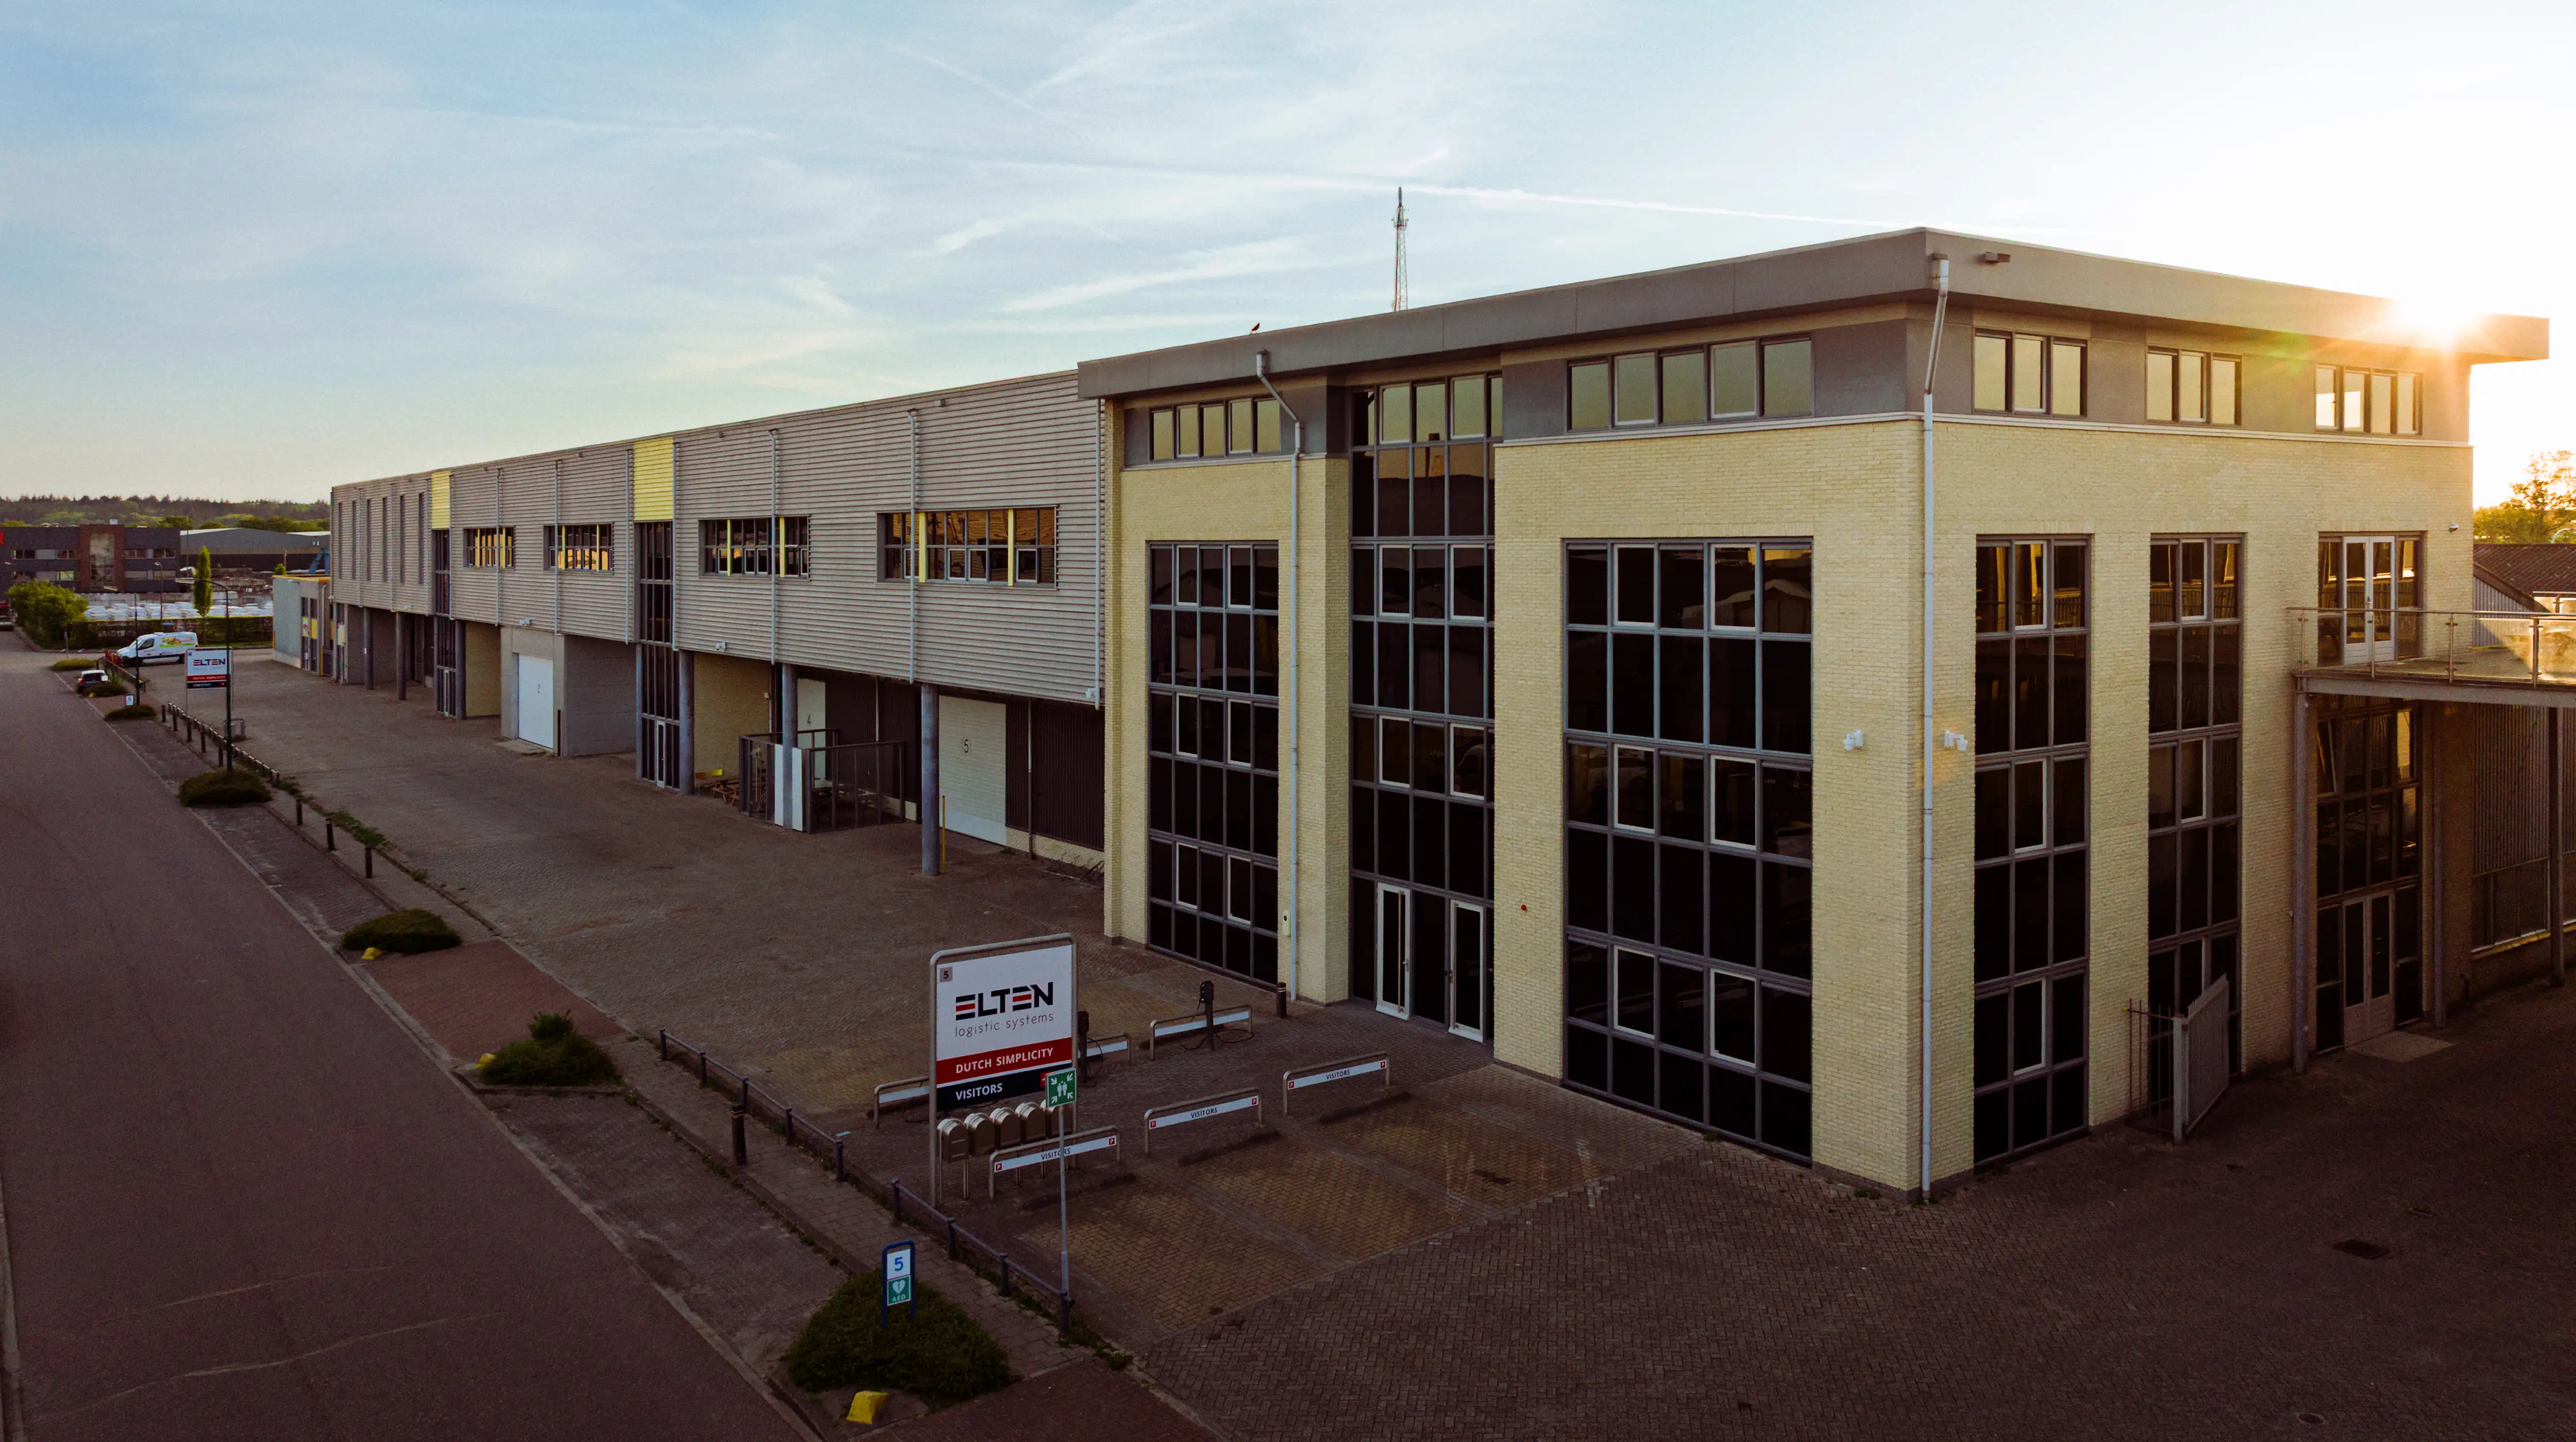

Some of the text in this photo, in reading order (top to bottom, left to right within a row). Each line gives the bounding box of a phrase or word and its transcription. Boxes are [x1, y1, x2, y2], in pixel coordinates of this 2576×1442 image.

[807, 714, 811, 726] 4
[964, 739, 969, 753] 5
[943, 970, 949, 979] 5
[956, 981, 1054, 1021] ELTEN
[955, 1013, 1054, 1038] logistic systems
[956, 1047, 1054, 1074] DUTCH SIMPLICITY
[1326, 1069, 1350, 1080] VISITORS
[955, 1083, 1003, 1101] VISITORS
[1191, 1107, 1217, 1118] VISITORS
[894, 1257, 904, 1271] 5
[892, 1294, 906, 1302] AED
